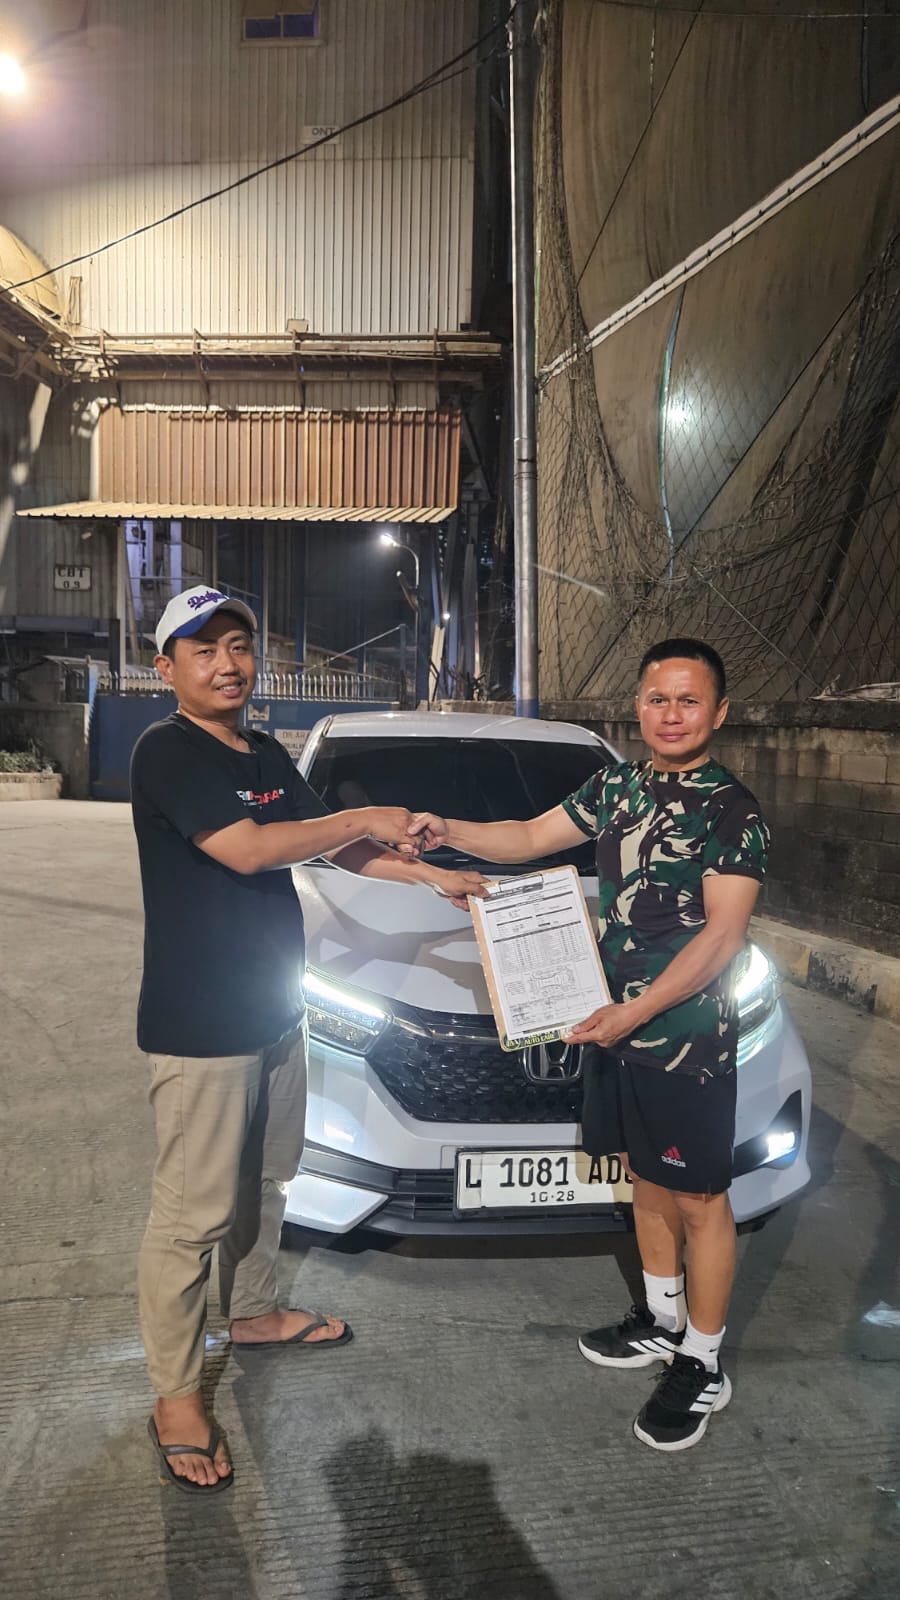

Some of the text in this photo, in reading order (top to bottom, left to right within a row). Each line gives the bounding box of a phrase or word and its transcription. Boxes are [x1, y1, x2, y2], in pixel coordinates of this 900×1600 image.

[465, 1158, 482, 1188] L
[499, 1156, 569, 1188] 1081
[661, 1155, 687, 1168] adidas
